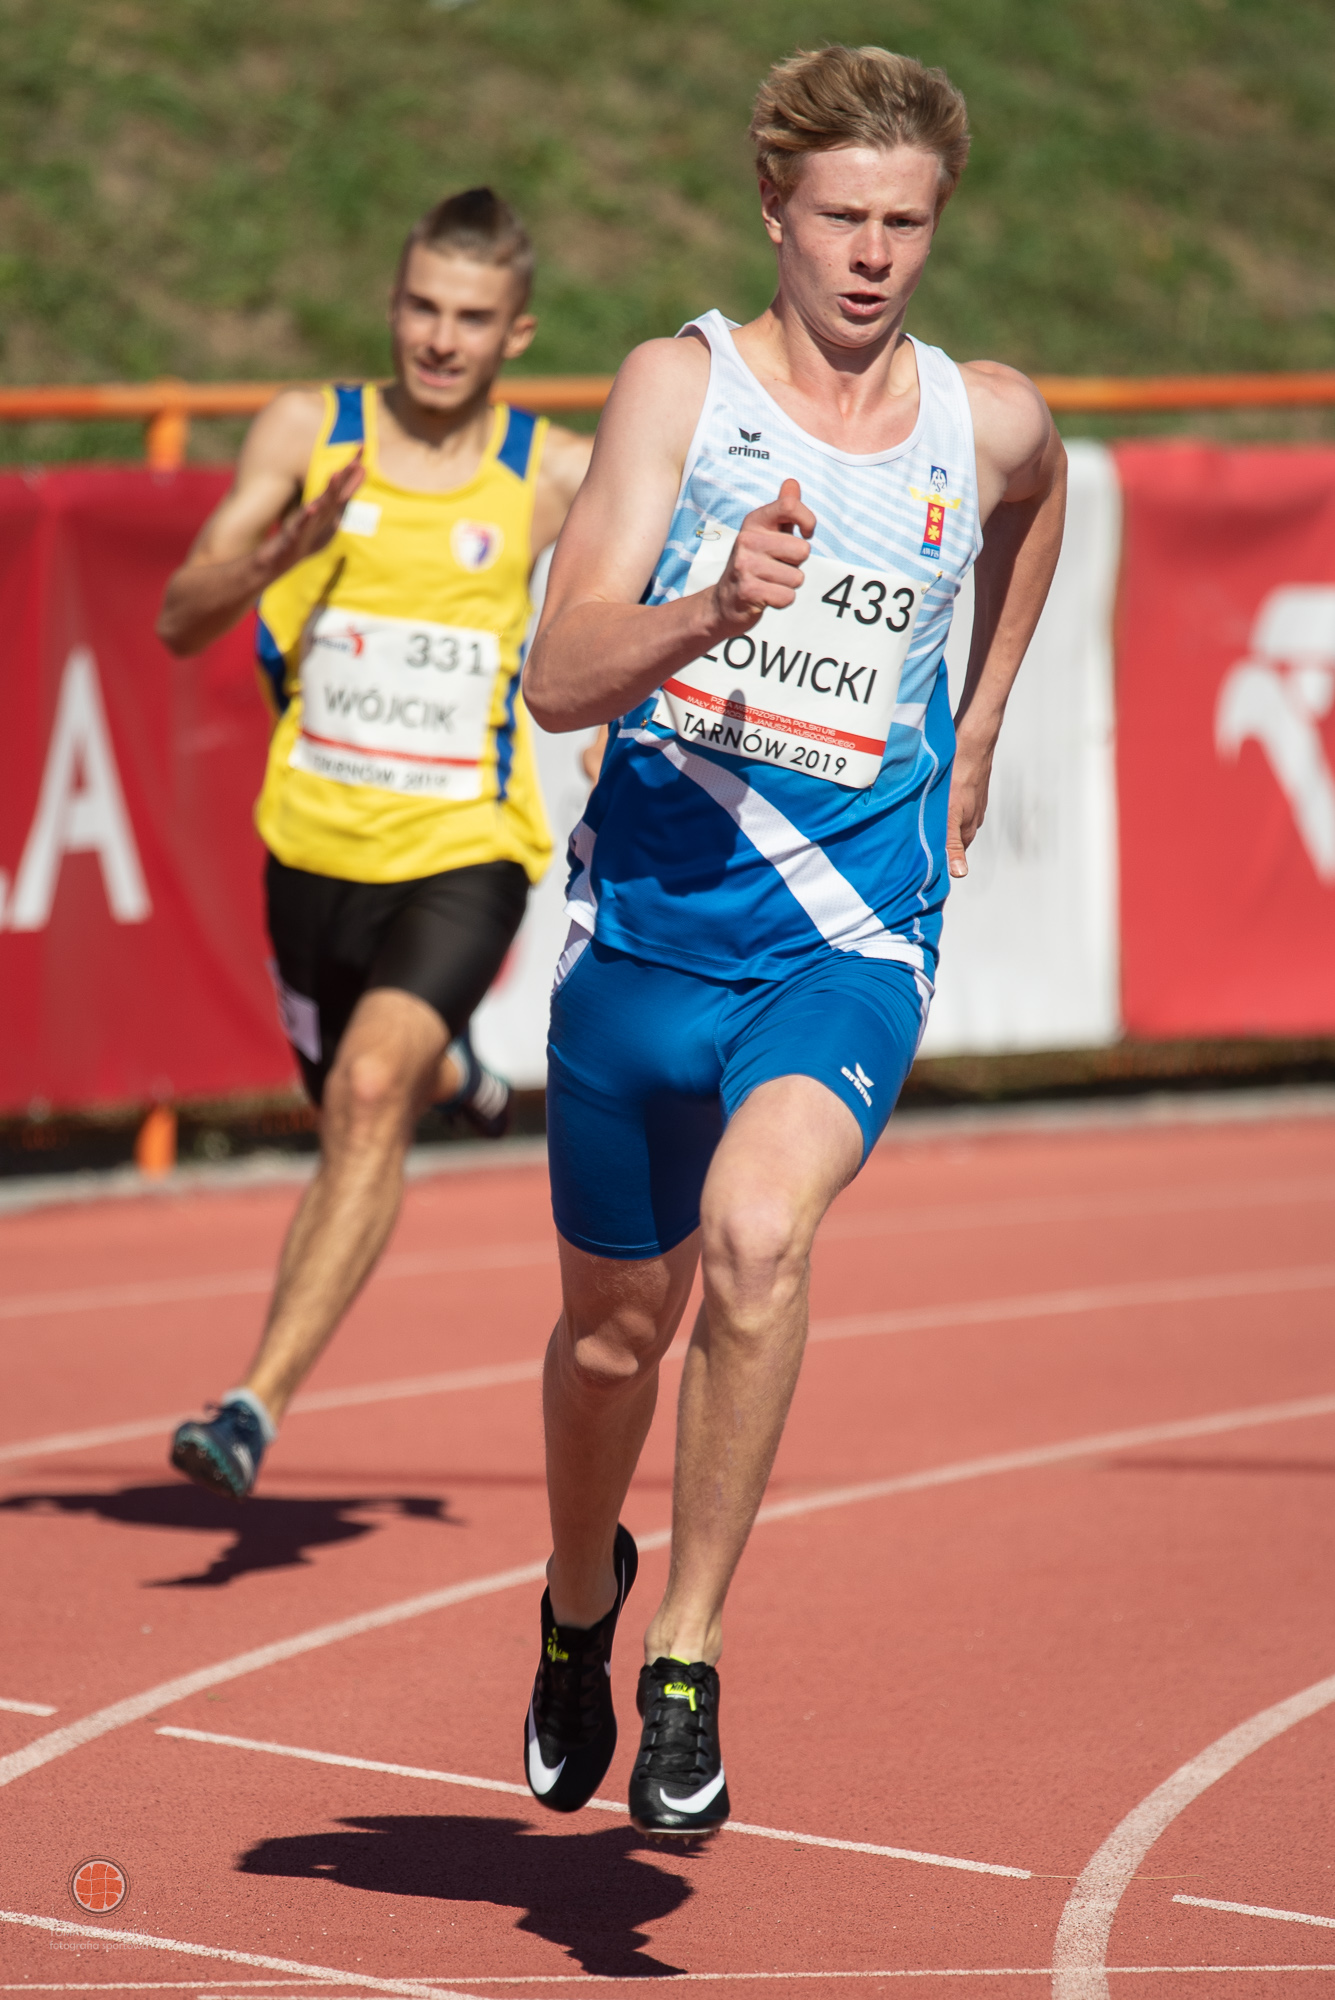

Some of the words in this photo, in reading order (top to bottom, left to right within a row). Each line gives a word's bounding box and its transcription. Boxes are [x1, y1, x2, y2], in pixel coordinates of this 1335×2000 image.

[728, 445, 770, 460] erima
[821, 574, 915, 633] 433
[406, 633, 487, 676] 331
[702, 633, 877, 705] OWICKI
[323, 683, 460, 732] WÓJCIK
[710, 696, 733, 708] PZLA
[733, 703, 792, 725] MISTRZOSTWA
[792, 719, 821, 732] POLSKI
[753, 718, 792, 733] JANUSZA
[683, 711, 787, 760] TARNÓW
[790, 746, 847, 776] 2019
